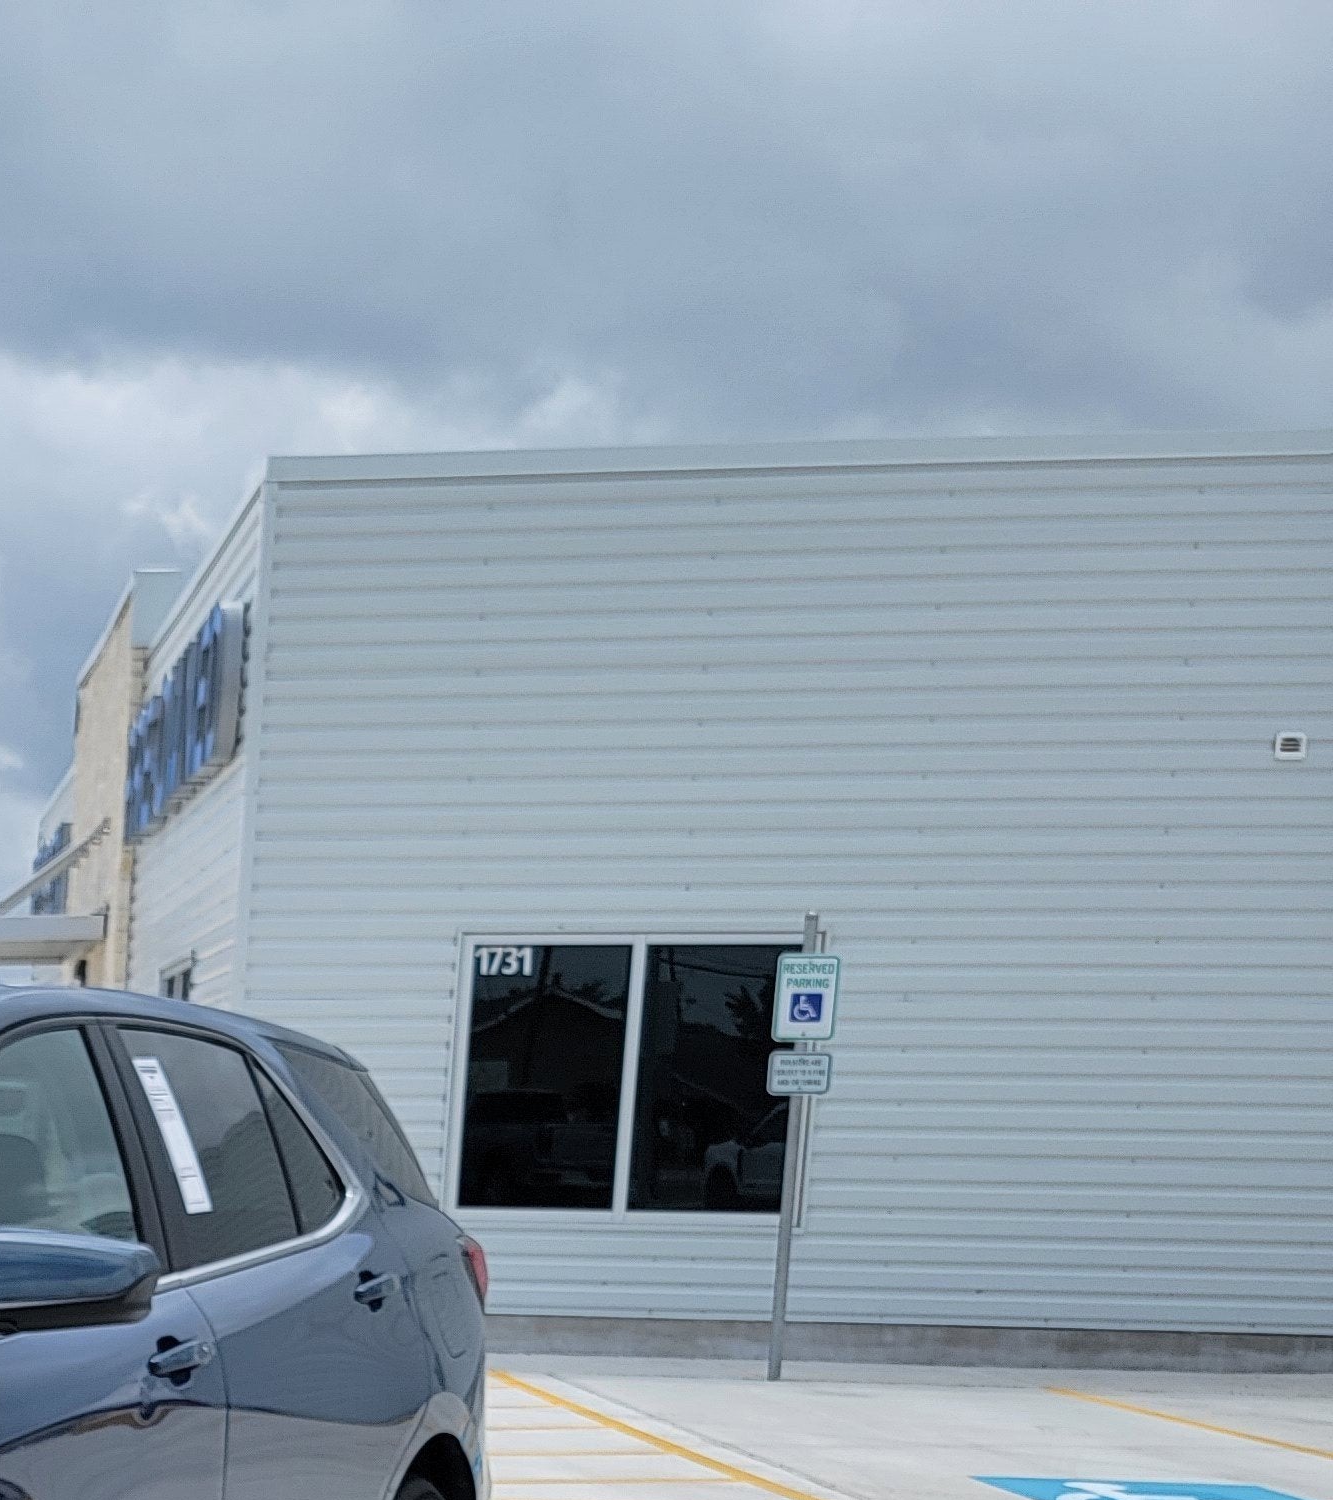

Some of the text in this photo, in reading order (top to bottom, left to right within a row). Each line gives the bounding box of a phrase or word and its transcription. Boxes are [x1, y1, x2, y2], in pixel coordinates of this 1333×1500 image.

[474, 946, 533, 977] 1731
[783, 962, 834, 975] RESERVED
[786, 977, 830, 989] PARKING
